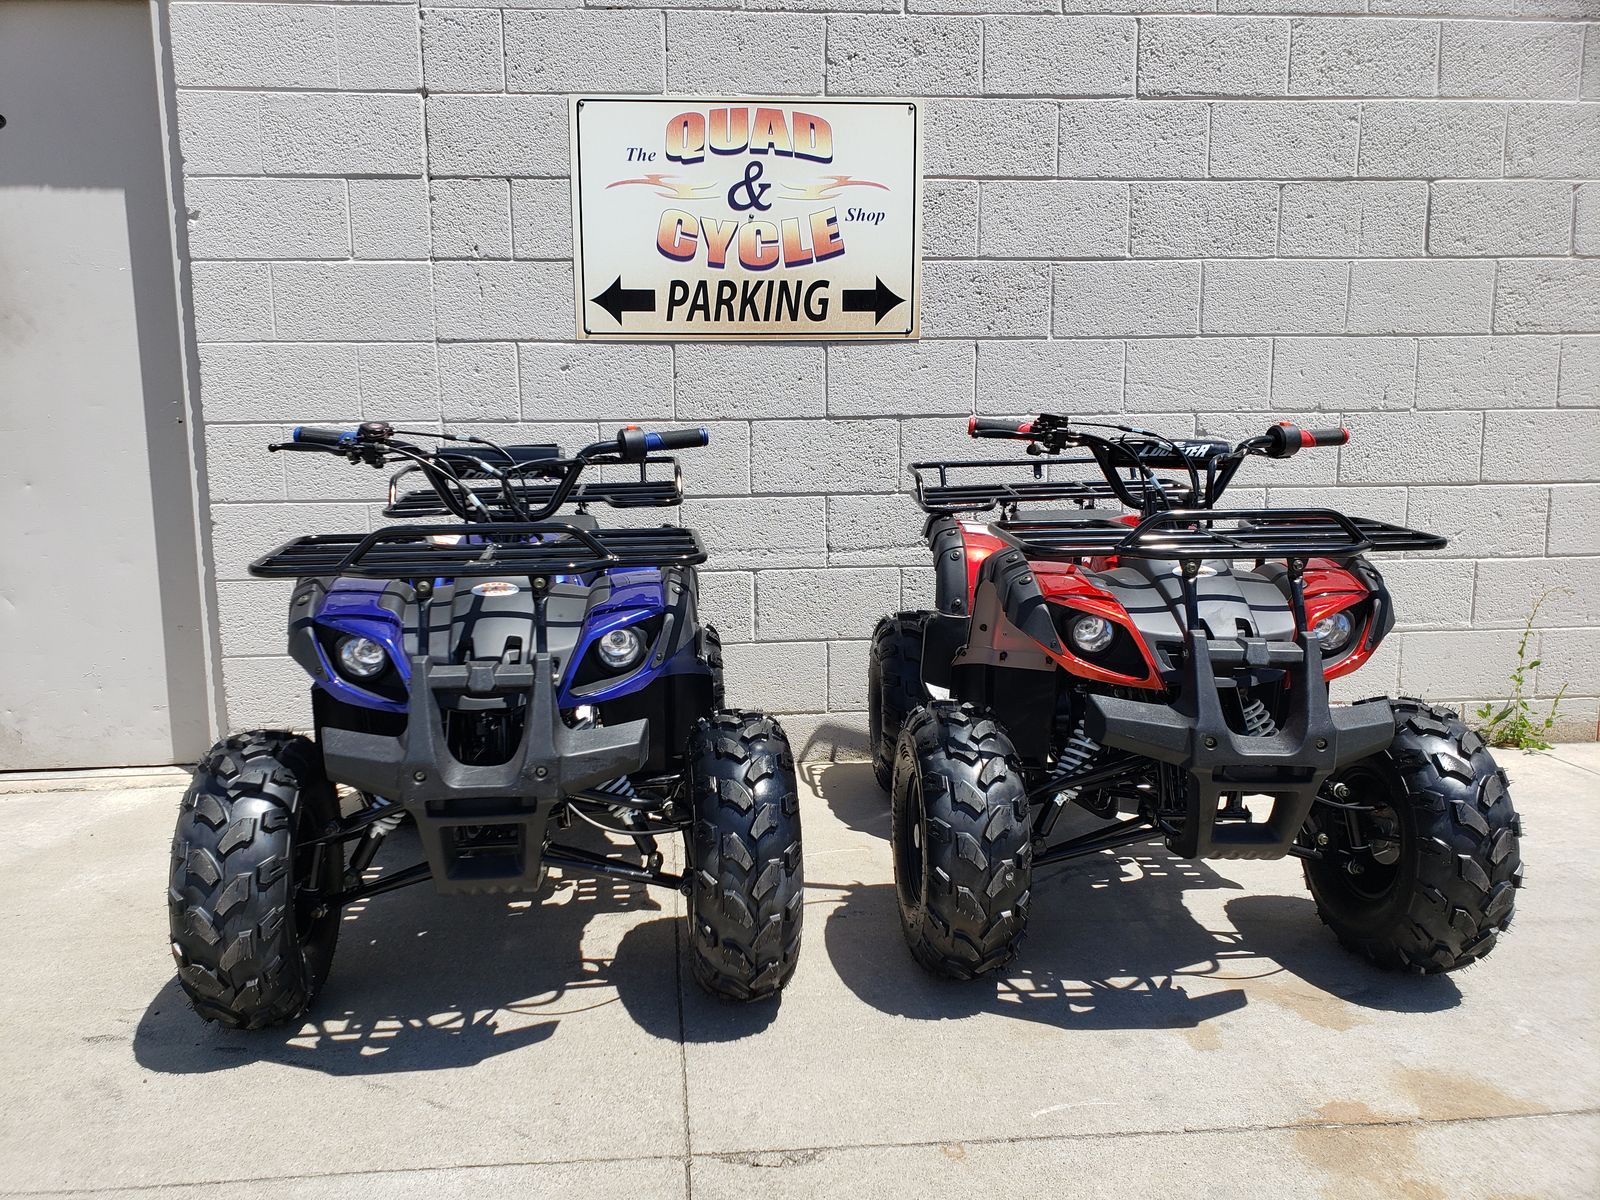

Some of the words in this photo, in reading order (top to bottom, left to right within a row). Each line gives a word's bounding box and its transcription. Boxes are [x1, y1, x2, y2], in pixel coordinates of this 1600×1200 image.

[626, 147, 657, 162] The
[665, 107, 833, 165] QUAD
[727, 160, 772, 211] &
[656, 207, 846, 271] CYCLE
[845, 207, 886, 225] Shop
[666, 279, 830, 322] PARKING
